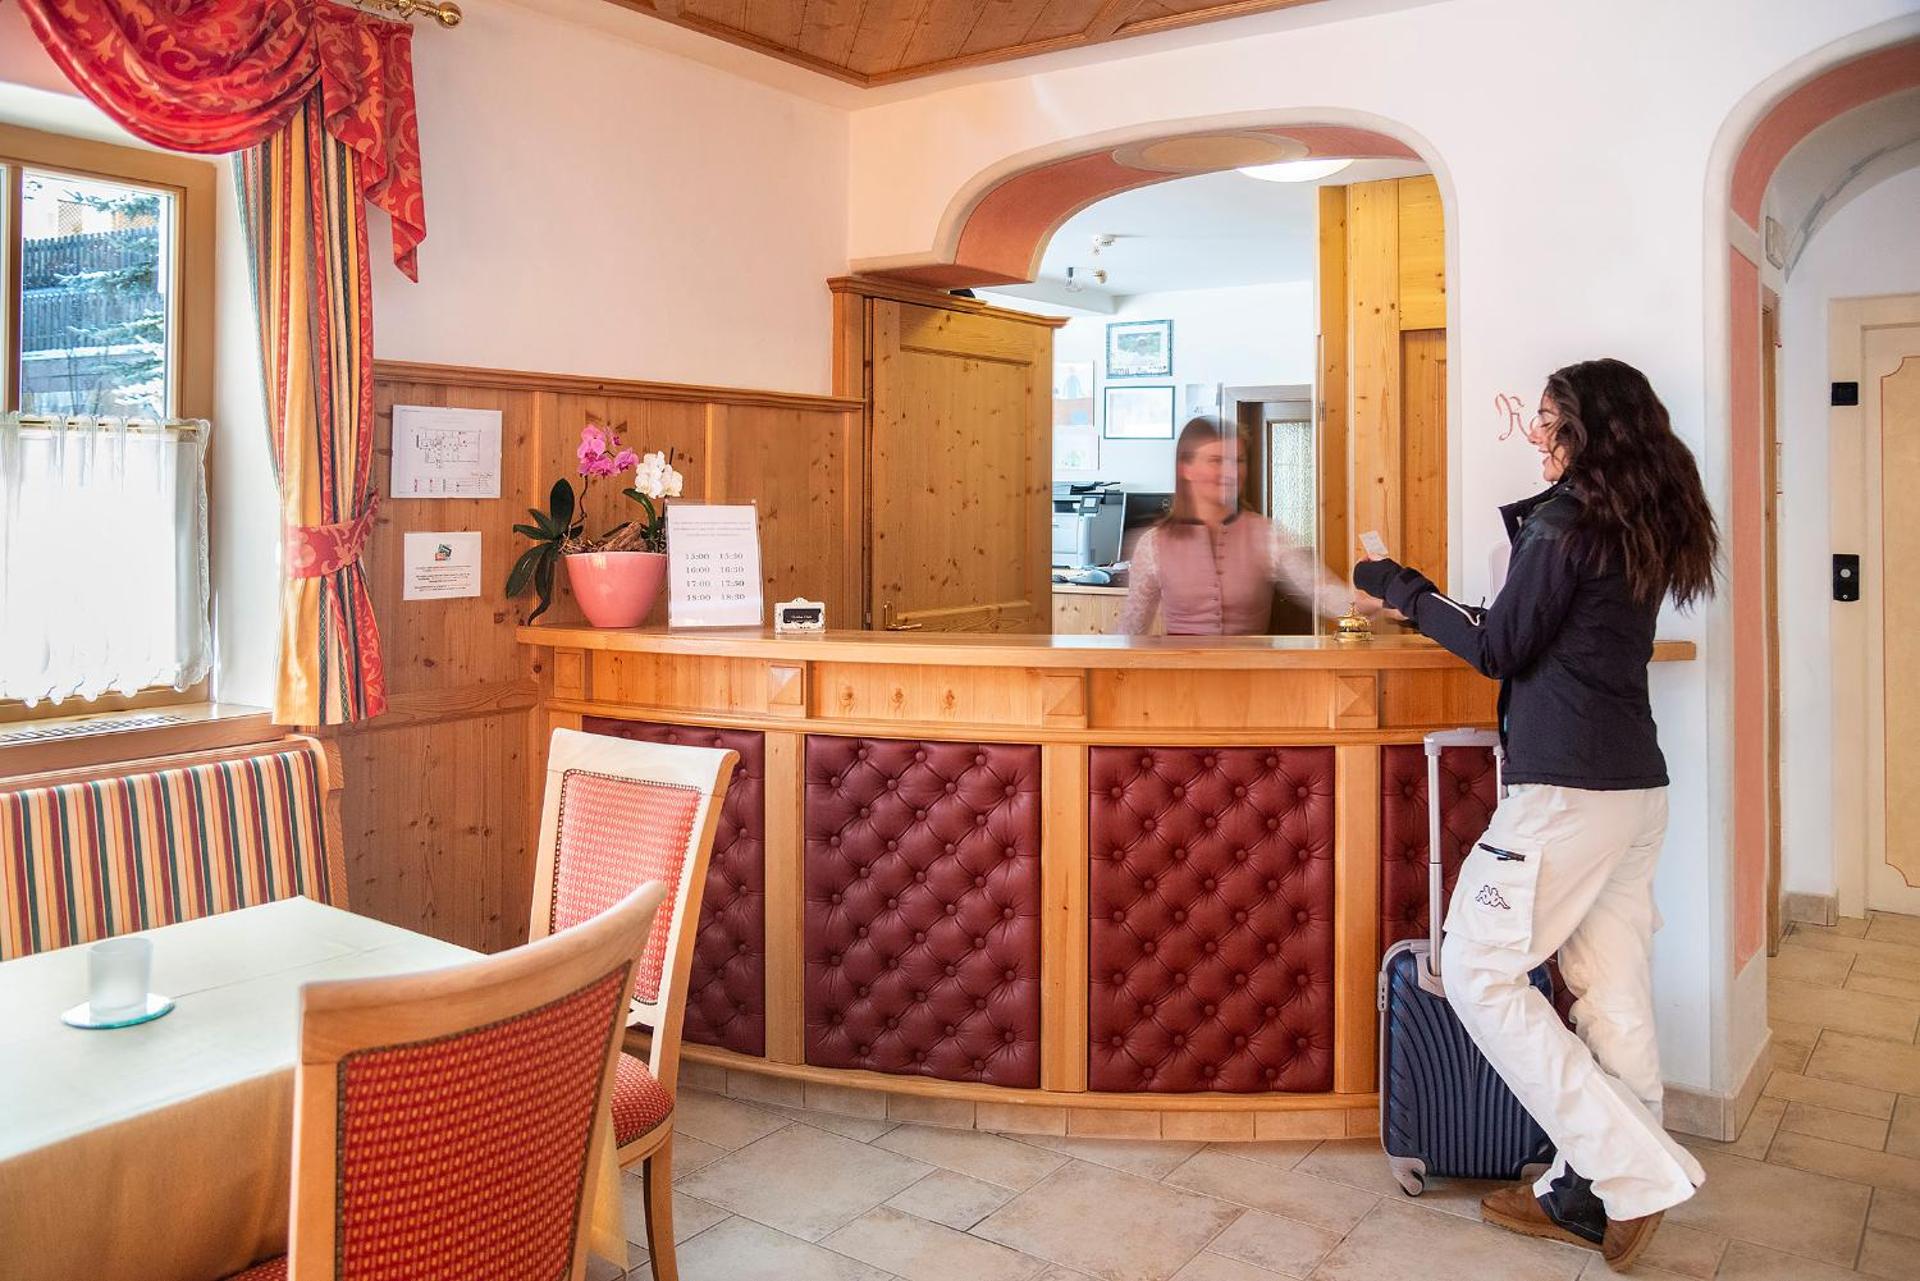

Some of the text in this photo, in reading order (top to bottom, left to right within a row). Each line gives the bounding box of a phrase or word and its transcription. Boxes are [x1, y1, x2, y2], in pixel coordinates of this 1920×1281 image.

[685, 552, 710, 560] 15:00
[686, 566, 710, 574] 16:00
[721, 593, 746, 601] 18:30
